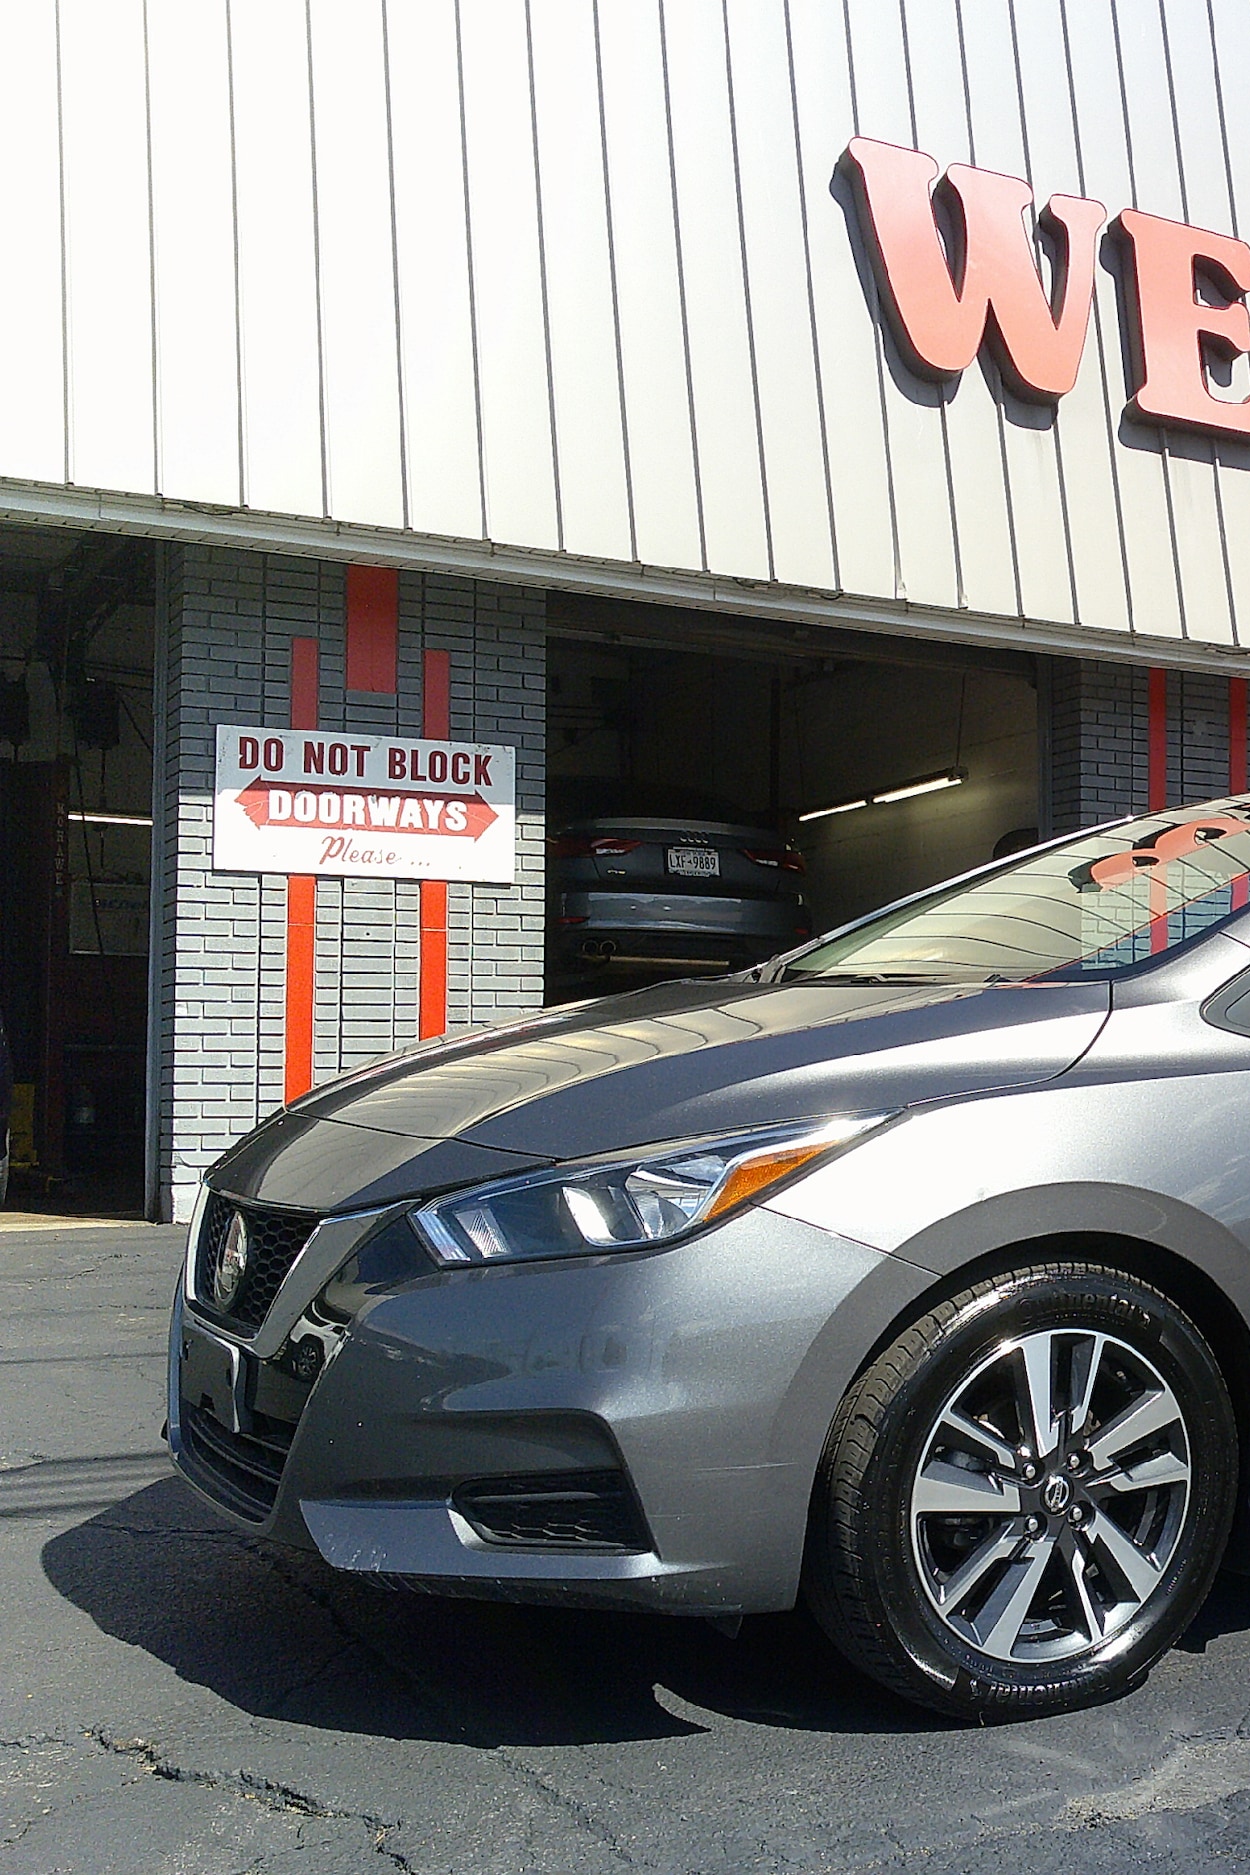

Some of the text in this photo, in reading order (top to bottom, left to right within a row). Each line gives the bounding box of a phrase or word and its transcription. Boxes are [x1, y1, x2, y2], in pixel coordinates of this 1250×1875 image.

[238, 735, 494, 787] DO NOT BLOCK
[267, 788, 469, 832] DOORWAYS
[318, 835, 398, 866] Please
